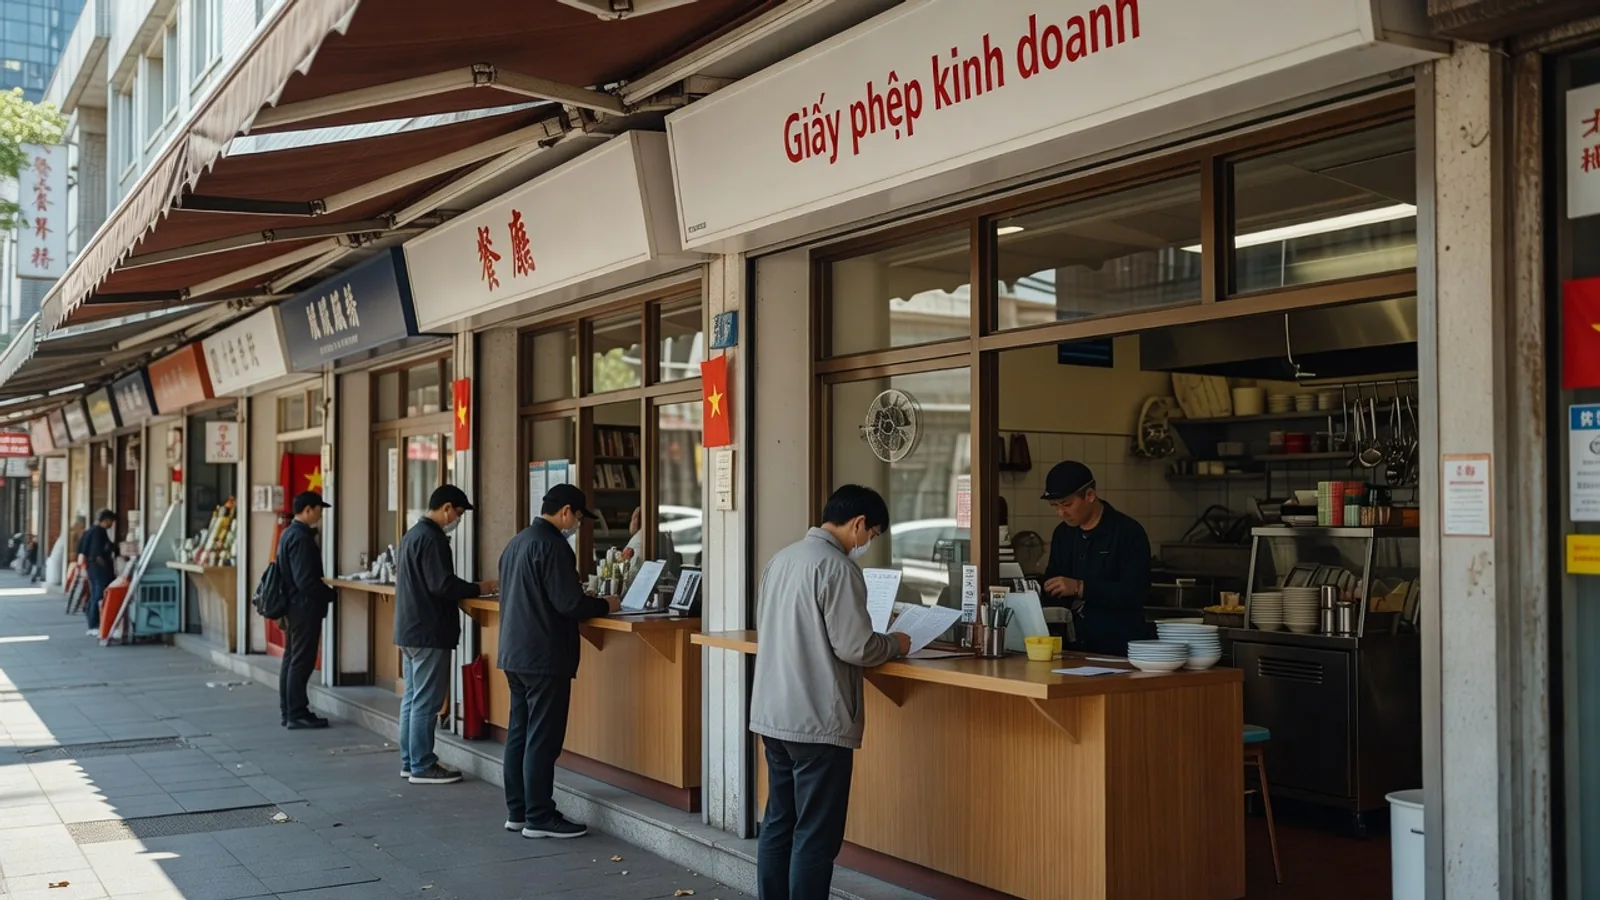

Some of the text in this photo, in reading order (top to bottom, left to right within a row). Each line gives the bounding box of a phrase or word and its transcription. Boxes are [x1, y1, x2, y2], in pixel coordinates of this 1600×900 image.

[783, 0, 1141, 165] Giấy phệp kinh doanh
